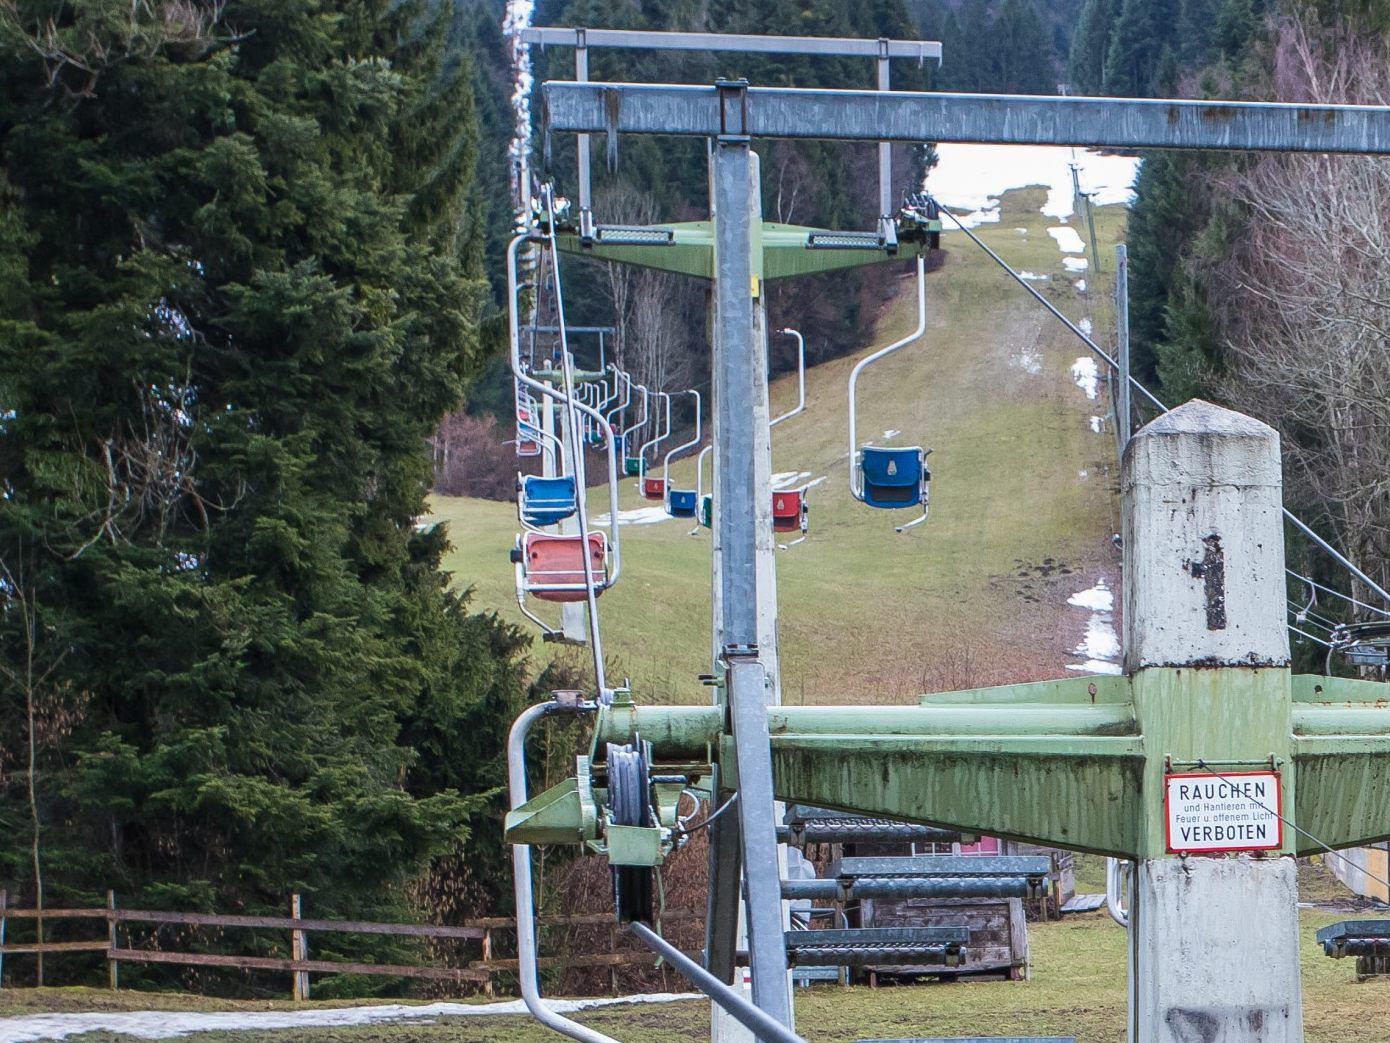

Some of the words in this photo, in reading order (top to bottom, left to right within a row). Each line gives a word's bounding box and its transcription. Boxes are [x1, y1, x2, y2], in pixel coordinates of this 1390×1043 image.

[1180, 782, 1265, 800] RAUCHEN
[1184, 803, 1200, 813] und
[1203, 802, 1246, 812] Hantieren
[1176, 814, 1200, 823] Feuer
[1213, 813, 1249, 822] offenem
[1181, 824, 1266, 842] VERBOTEN
